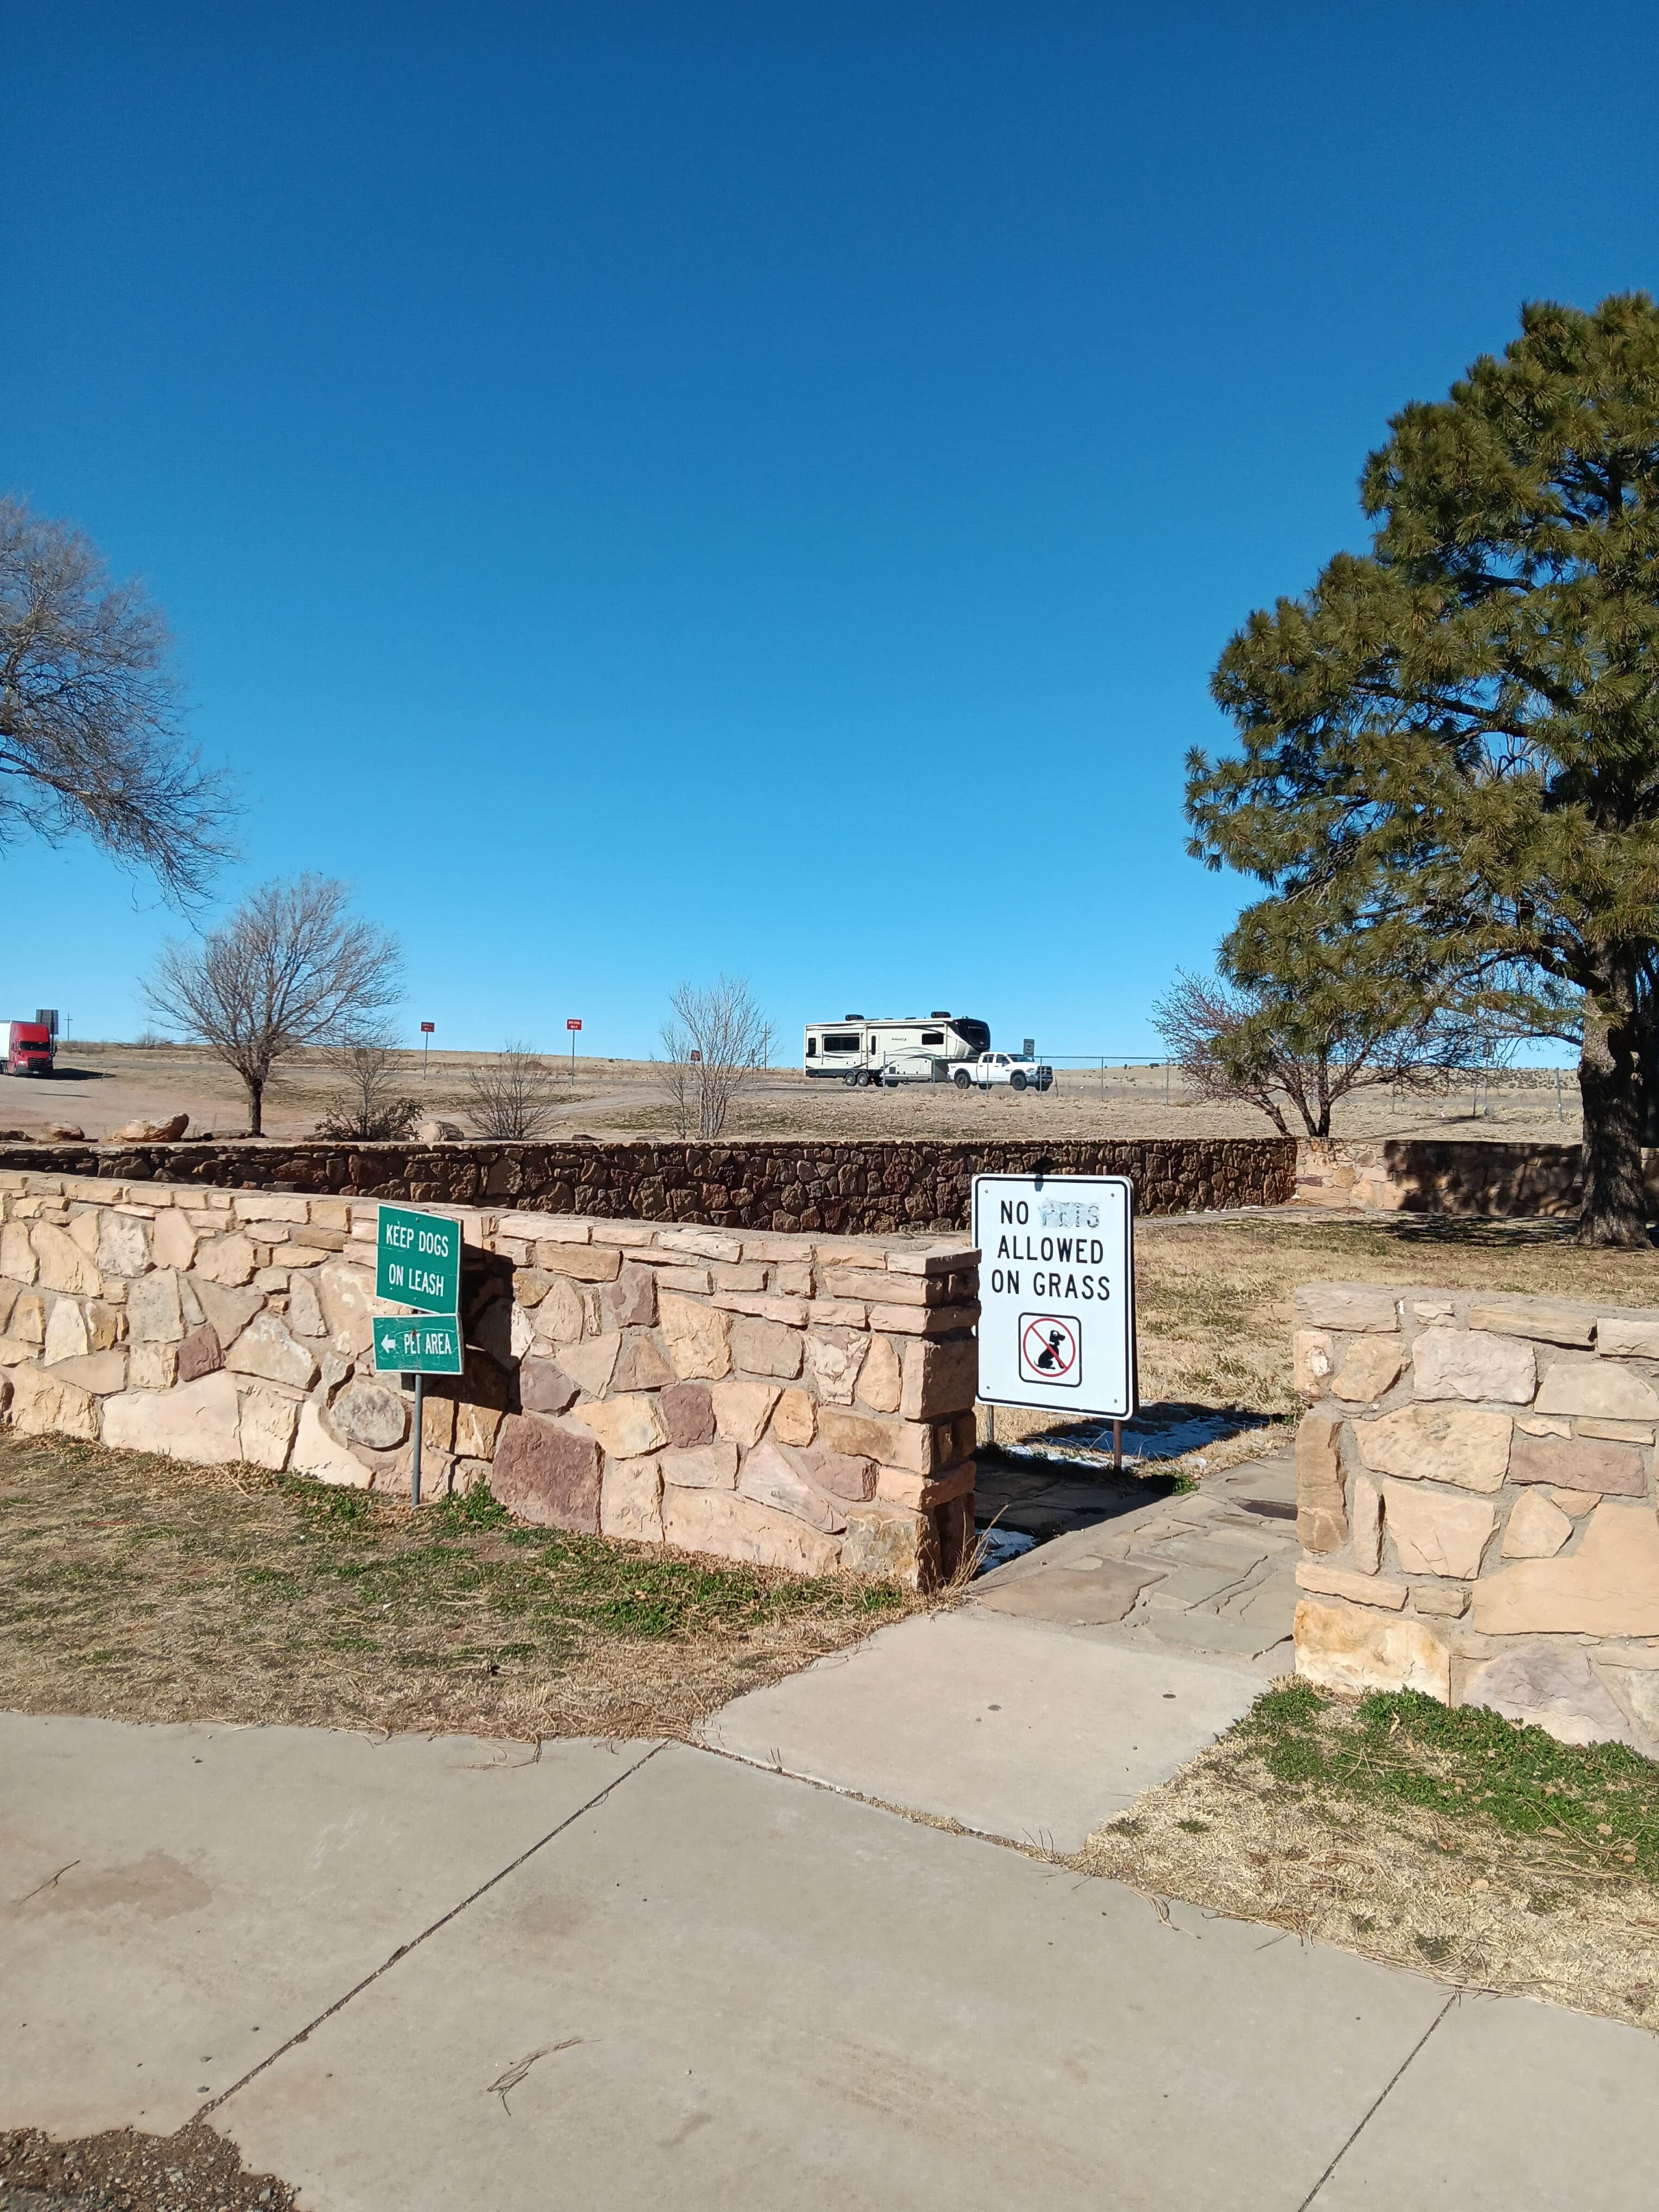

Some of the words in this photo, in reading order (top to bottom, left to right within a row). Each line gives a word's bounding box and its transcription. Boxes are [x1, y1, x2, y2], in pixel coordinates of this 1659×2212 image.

[1001, 1200, 1028, 1225] NO
[386, 1224, 414, 1249] KEEP
[419, 1231, 448, 1257] DOGS
[998, 1235, 1103, 1264] ALLOWED
[389, 1264, 403, 1287] ON
[408, 1269, 444, 1297] LEASH
[992, 1269, 1019, 1294] ON
[1033, 1272, 1110, 1300] GRASS
[404, 1333, 421, 1354] PET
[426, 1333, 452, 1354] AREA
